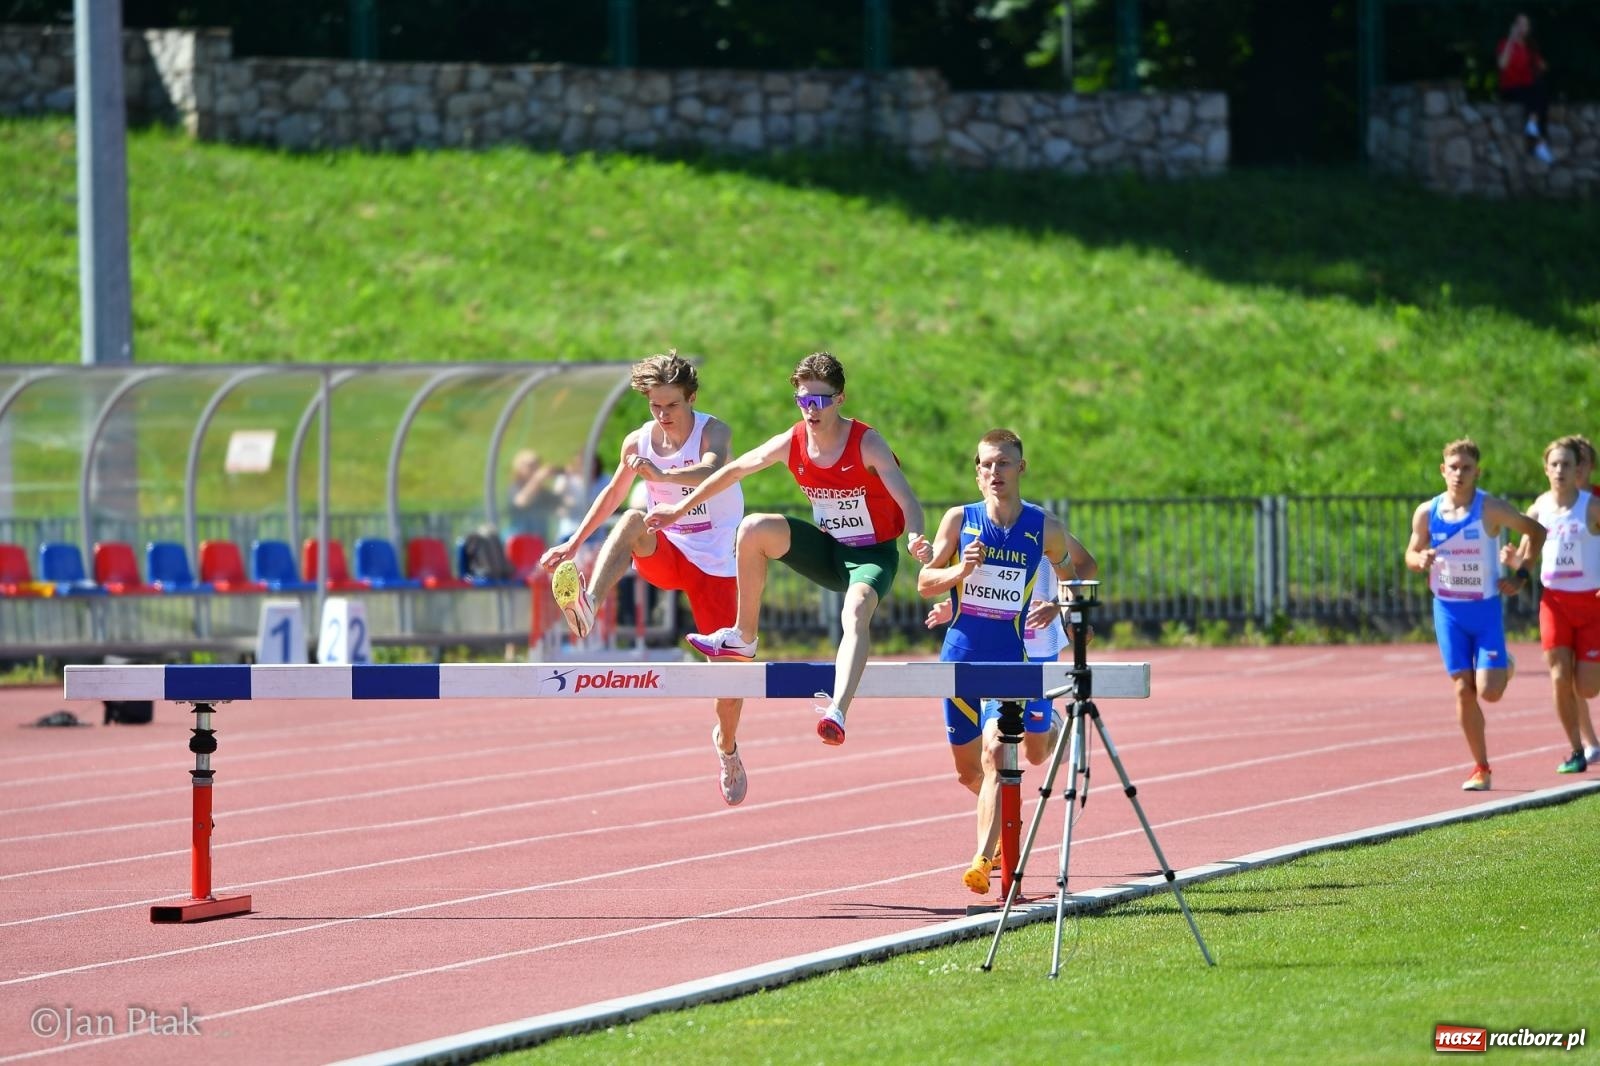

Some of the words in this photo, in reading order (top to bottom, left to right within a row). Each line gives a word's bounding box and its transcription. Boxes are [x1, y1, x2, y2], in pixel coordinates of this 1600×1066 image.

[838, 500, 859, 510] 257
[820, 516, 864, 530] ACSÁDI
[998, 569, 1020, 581] 457
[964, 582, 1021, 602] LYSENKO
[271, 618, 291, 663] 1
[350, 616, 367, 662] 2
[575, 670, 660, 693] polanik
